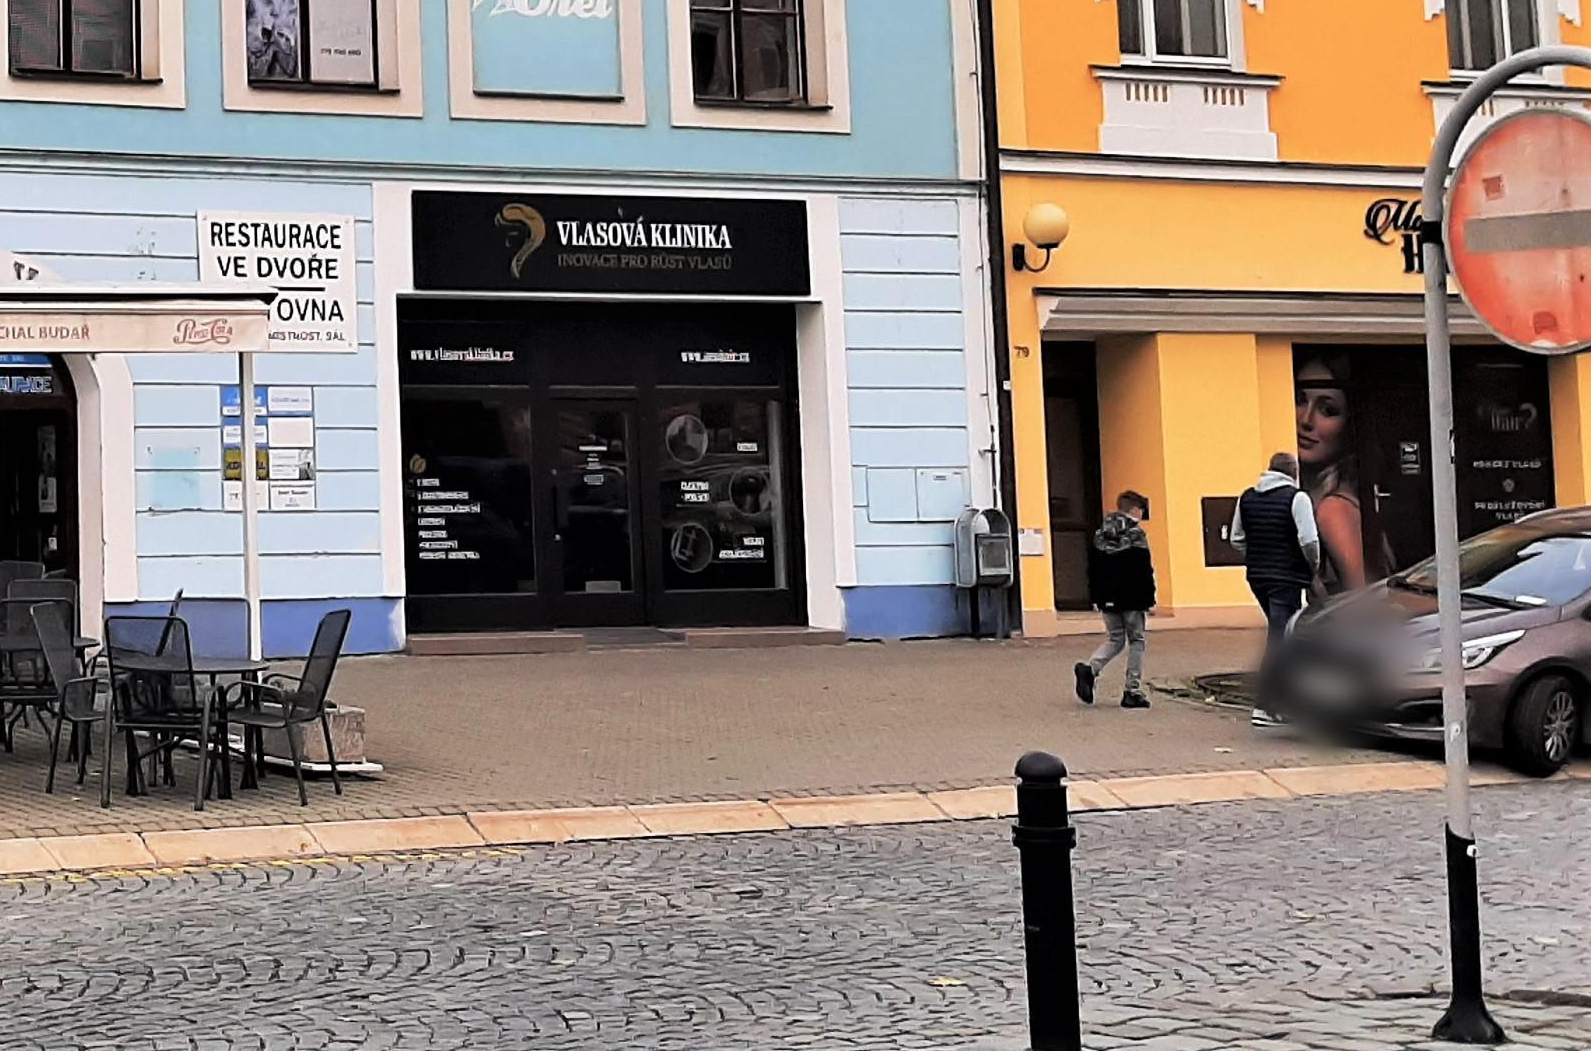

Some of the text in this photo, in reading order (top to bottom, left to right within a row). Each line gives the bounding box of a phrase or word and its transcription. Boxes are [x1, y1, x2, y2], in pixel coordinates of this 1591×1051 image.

[210, 222, 341, 249] RESTAURACE
[557, 215, 733, 249] VLASOVÁ KLINIKA
[217, 252, 339, 279] VE DVOŘE
[558, 254, 618, 268] INOVACE
[619, 254, 648, 268] PRO
[277, 298, 344, 321] OVNA
